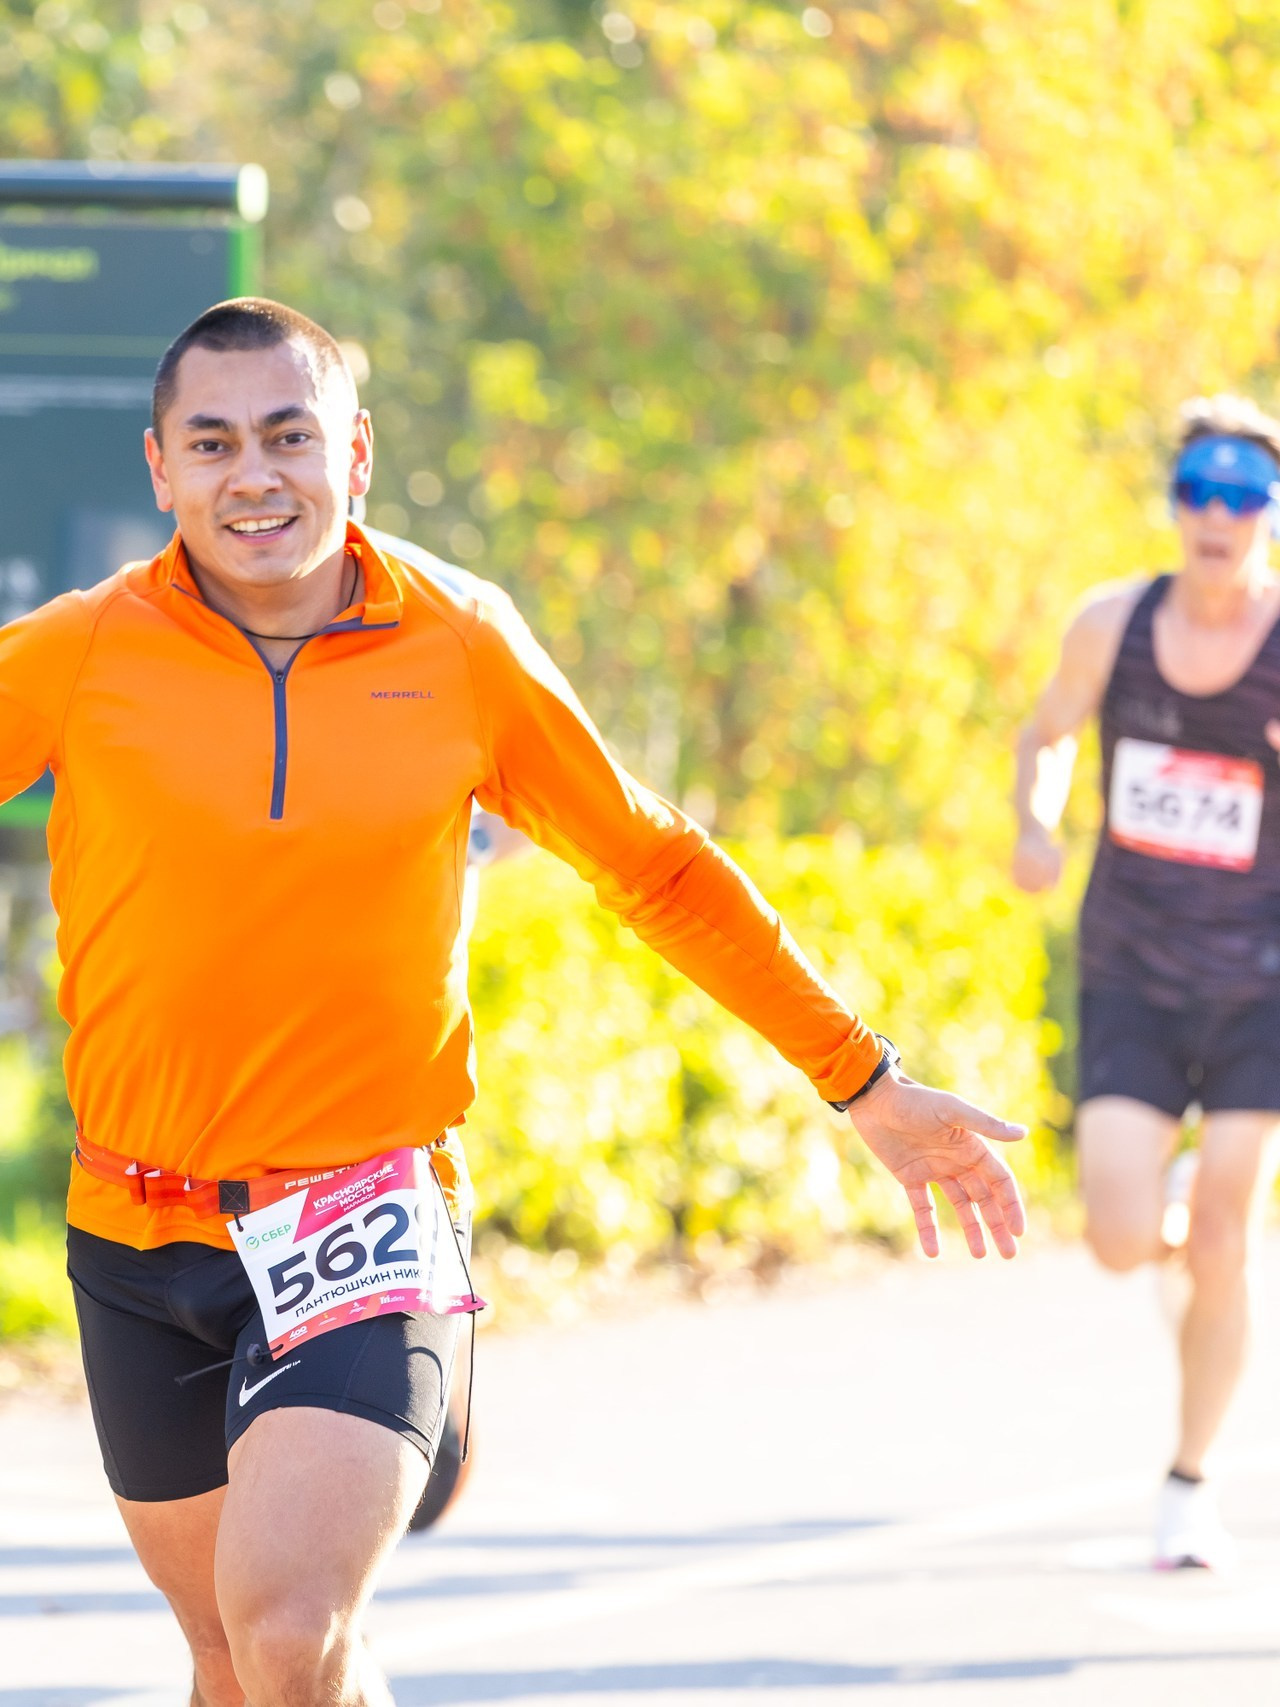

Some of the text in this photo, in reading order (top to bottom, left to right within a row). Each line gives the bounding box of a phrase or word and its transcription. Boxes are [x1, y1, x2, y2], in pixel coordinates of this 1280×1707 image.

[370, 690, 435, 699] MERRELL
[312, 1163, 395, 1210] КРАСНОЯРСКИЕ
[339, 1182, 377, 1208] МОСТЫ
[343, 1191, 376, 1212] МАРАФОН
[261, 1223, 292, 1243] СБЕР
[295, 1270, 391, 1318] ПАНТЮШКИН
